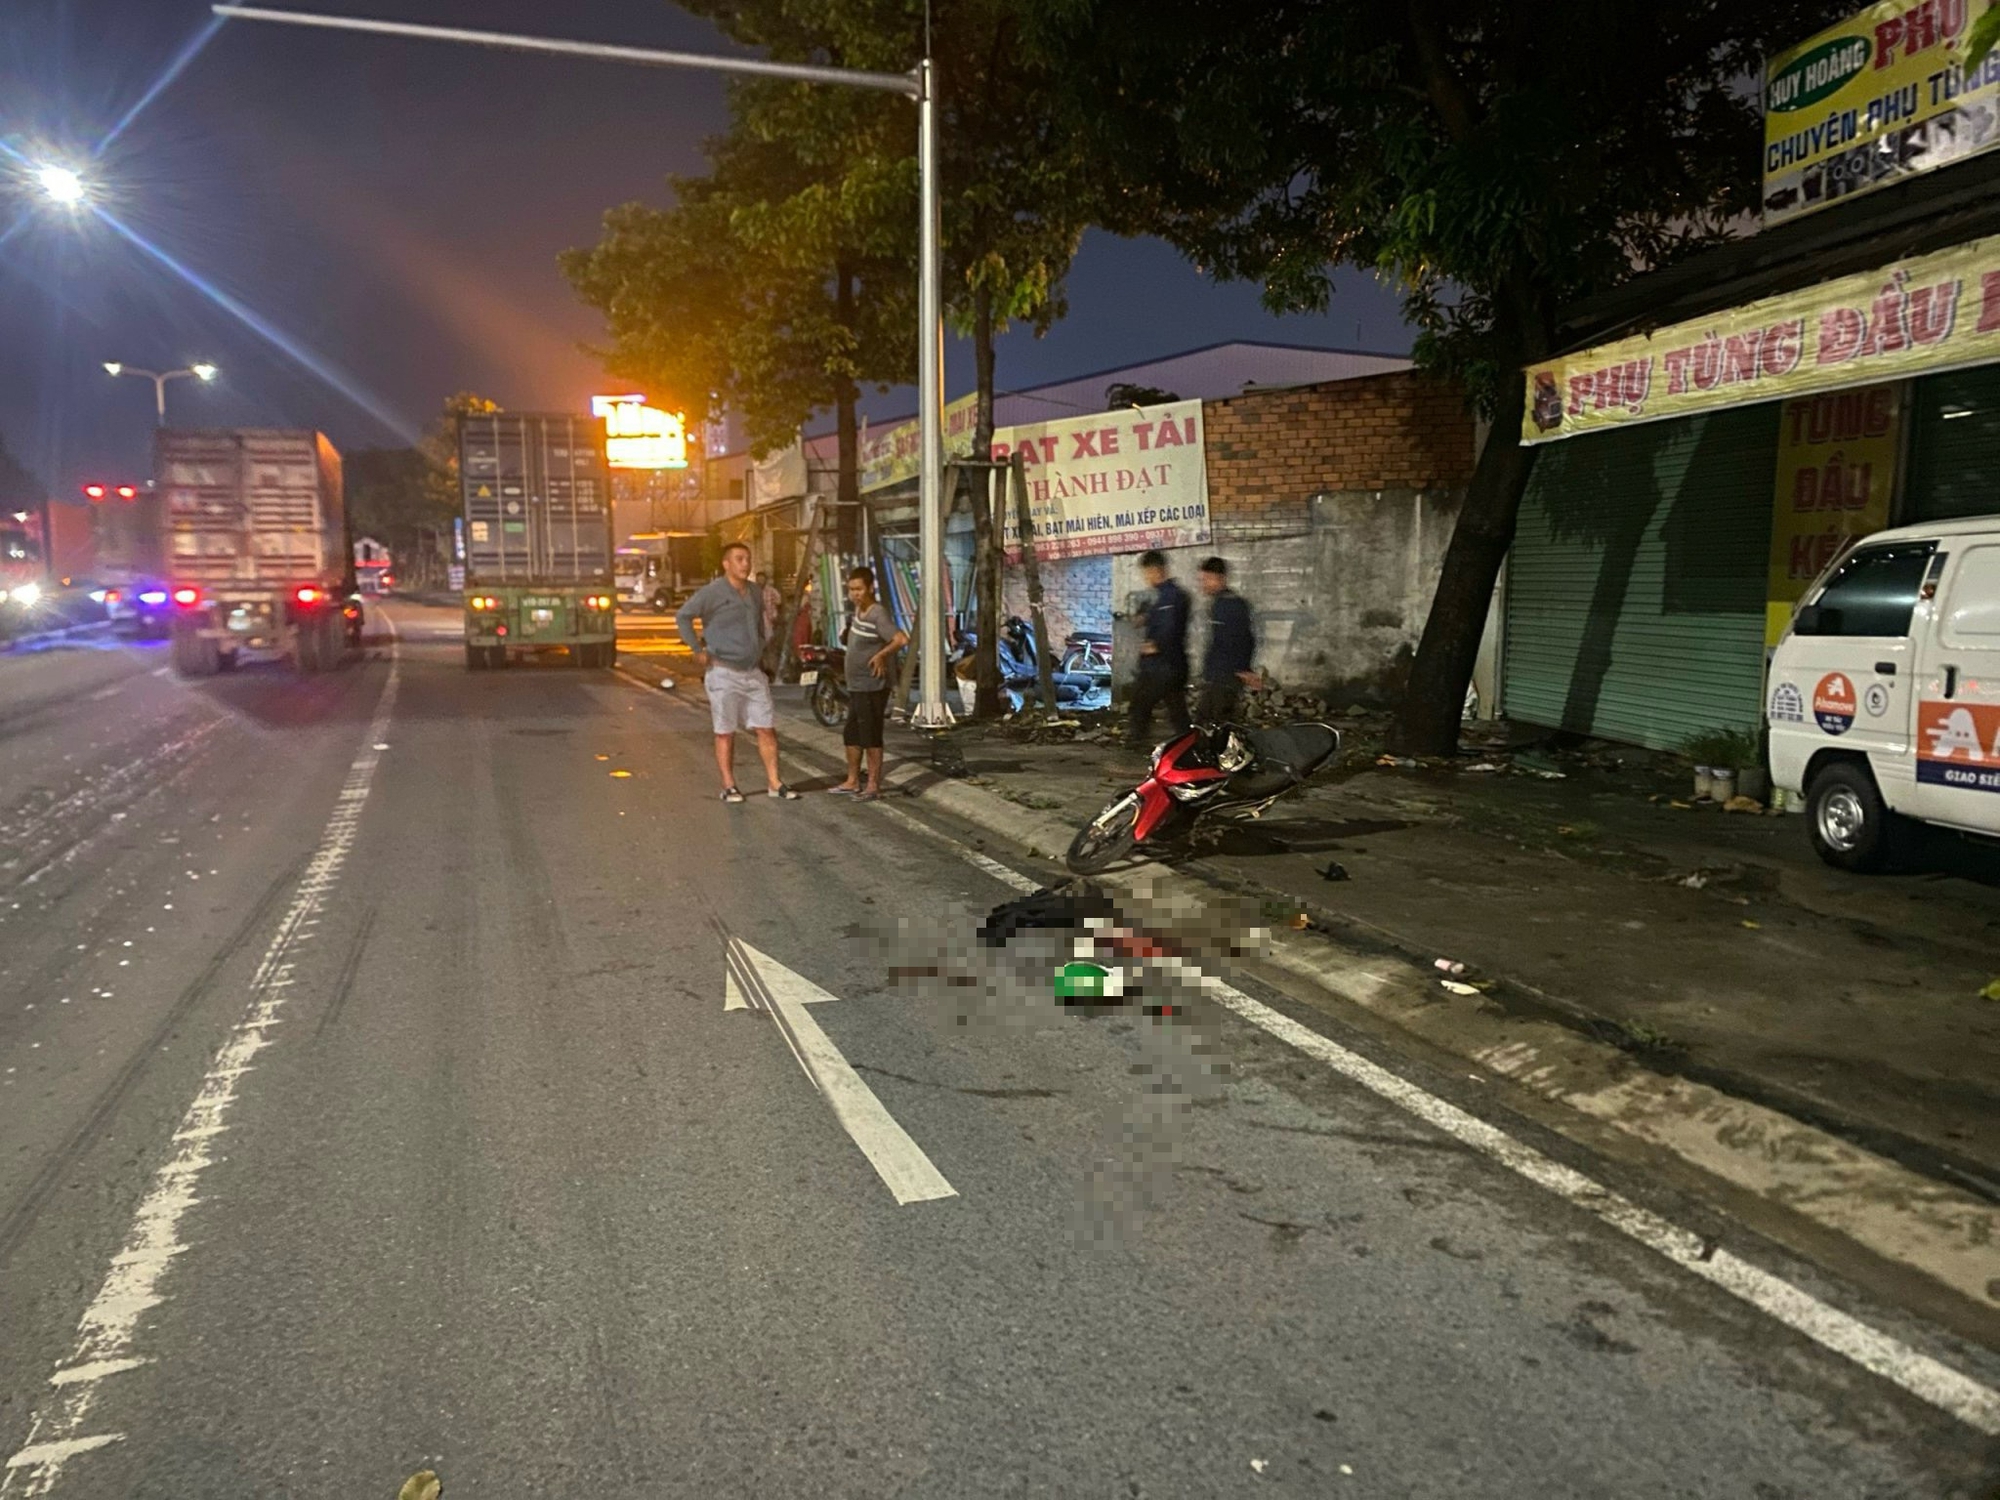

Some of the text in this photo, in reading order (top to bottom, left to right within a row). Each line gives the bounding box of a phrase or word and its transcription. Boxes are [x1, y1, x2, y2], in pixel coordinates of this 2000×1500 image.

[1874, 0, 1967, 70] PHỤ
[1769, 40, 1865, 110] HUY HOÀNG
[1766, 111, 1857, 173] CHUYÊN
[1867, 83, 1918, 132] PHỤ
[1568, 356, 1653, 415] PHỤ
[1664, 318, 1804, 395] TÙNG
[1816, 269, 1961, 365] ĐẦU
[1072, 428, 1120, 460] XE
[1132, 413, 1197, 450] TẢI
[1027, 463, 1172, 501] HÀNH ĐẠT
[1046, 521, 1063, 537] BẠT
[1066, 516, 1085, 533] MÁI
[1115, 510, 1135, 527] MÁI
[1137, 506, 1157, 525] XẾP
[1159, 505, 1180, 522] CÁC
[1788, 524, 1864, 580] KÉ
[1945, 769, 1977, 784] GIAO
